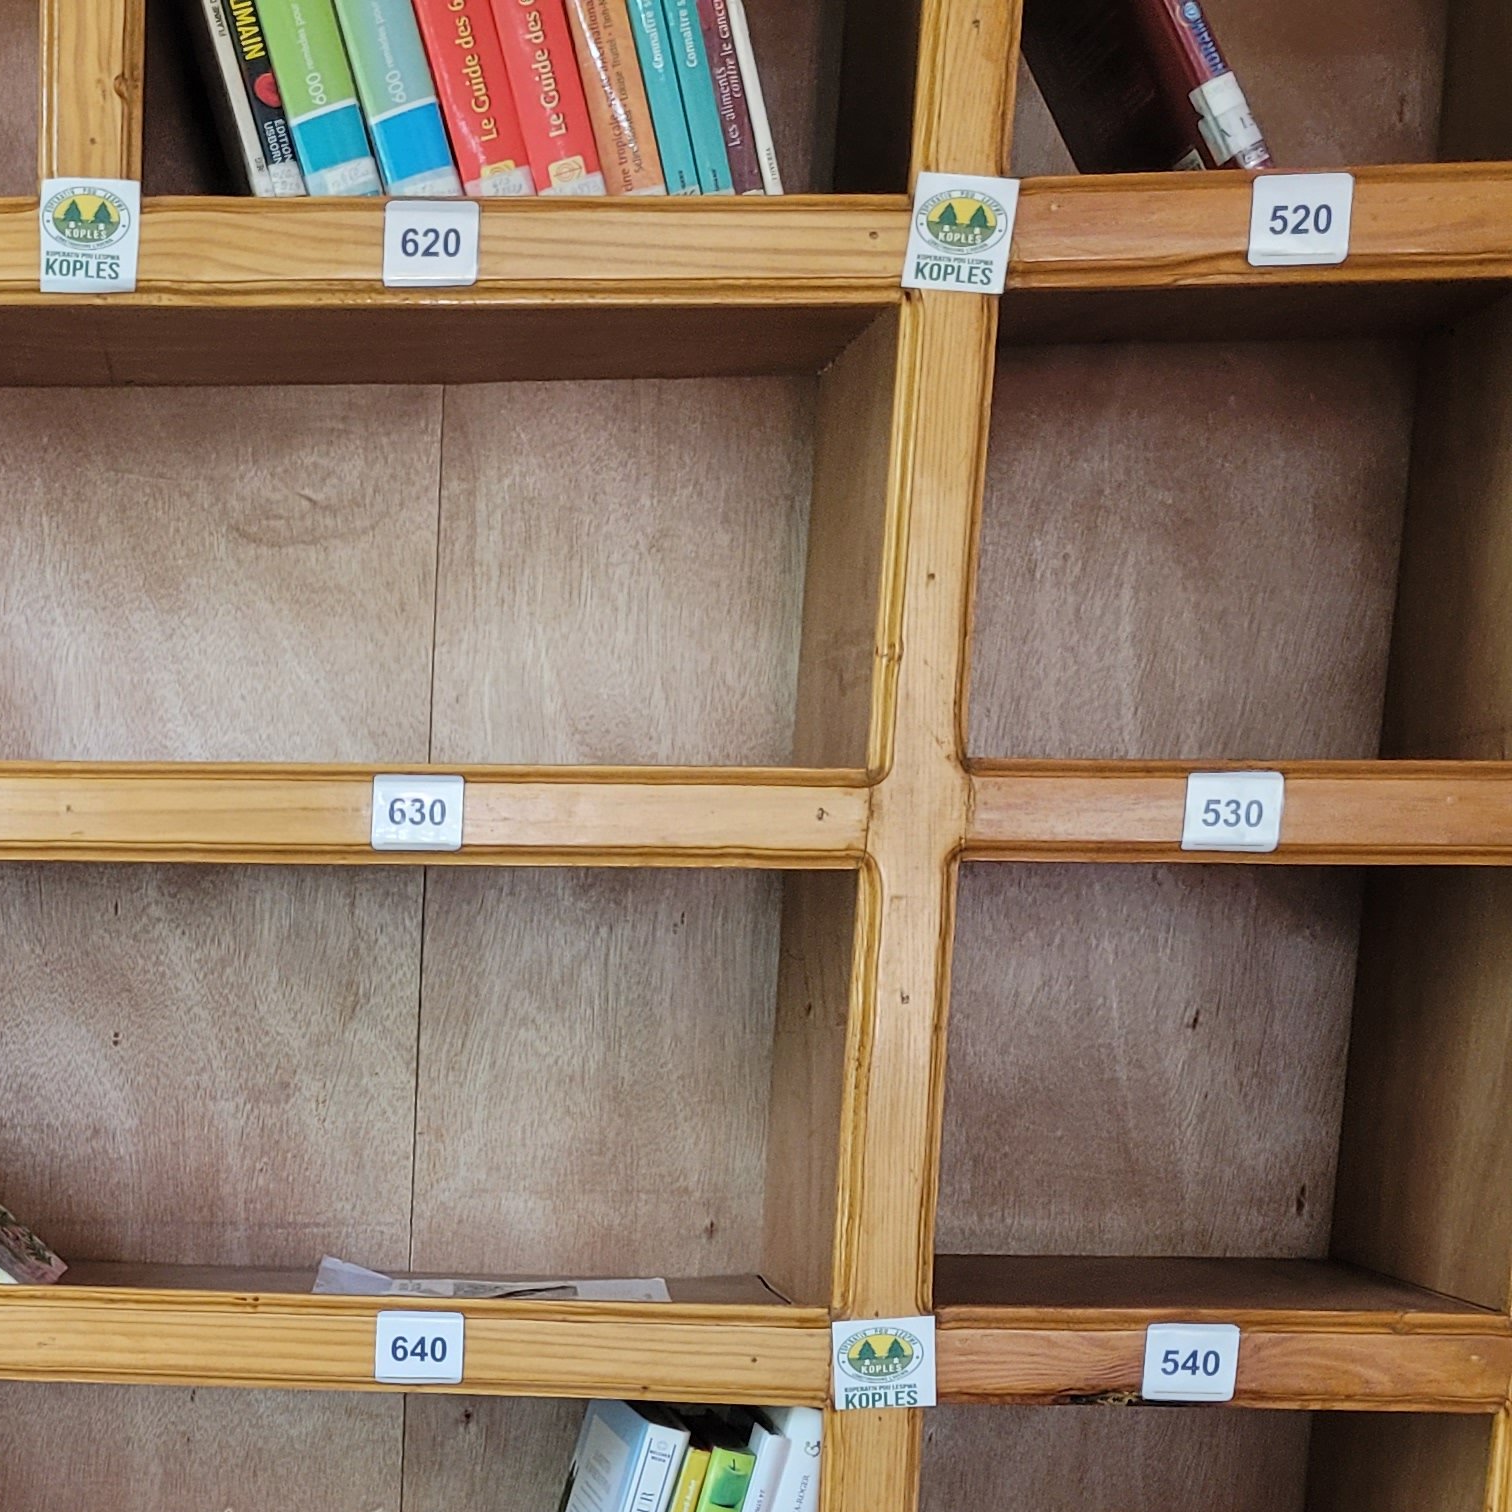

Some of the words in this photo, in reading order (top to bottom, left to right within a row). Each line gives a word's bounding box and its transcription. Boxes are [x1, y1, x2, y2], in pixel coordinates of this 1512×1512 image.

[451, 16, 474, 50] des
[520, 11, 545, 44] des
[305, 72, 328, 106] 600
[385, 69, 409, 104] 600
[462, 53, 492, 113] Guide
[531, 49, 561, 108] Guide
[478, 115, 499, 142] Le
[547, 112, 568, 138] Le
[1269, 203, 1332, 235] 520
[401, 228, 461, 258] 620
[45, 257, 121, 280] KOPLES
[913, 261, 994, 286] KOPLES
[388, 797, 447, 826] 630
[1201, 799, 1264, 828] 530
[391, 1335, 447, 1363] 640
[1161, 1349, 1221, 1377] 540
[844, 1390, 919, 1410] KOPLES
